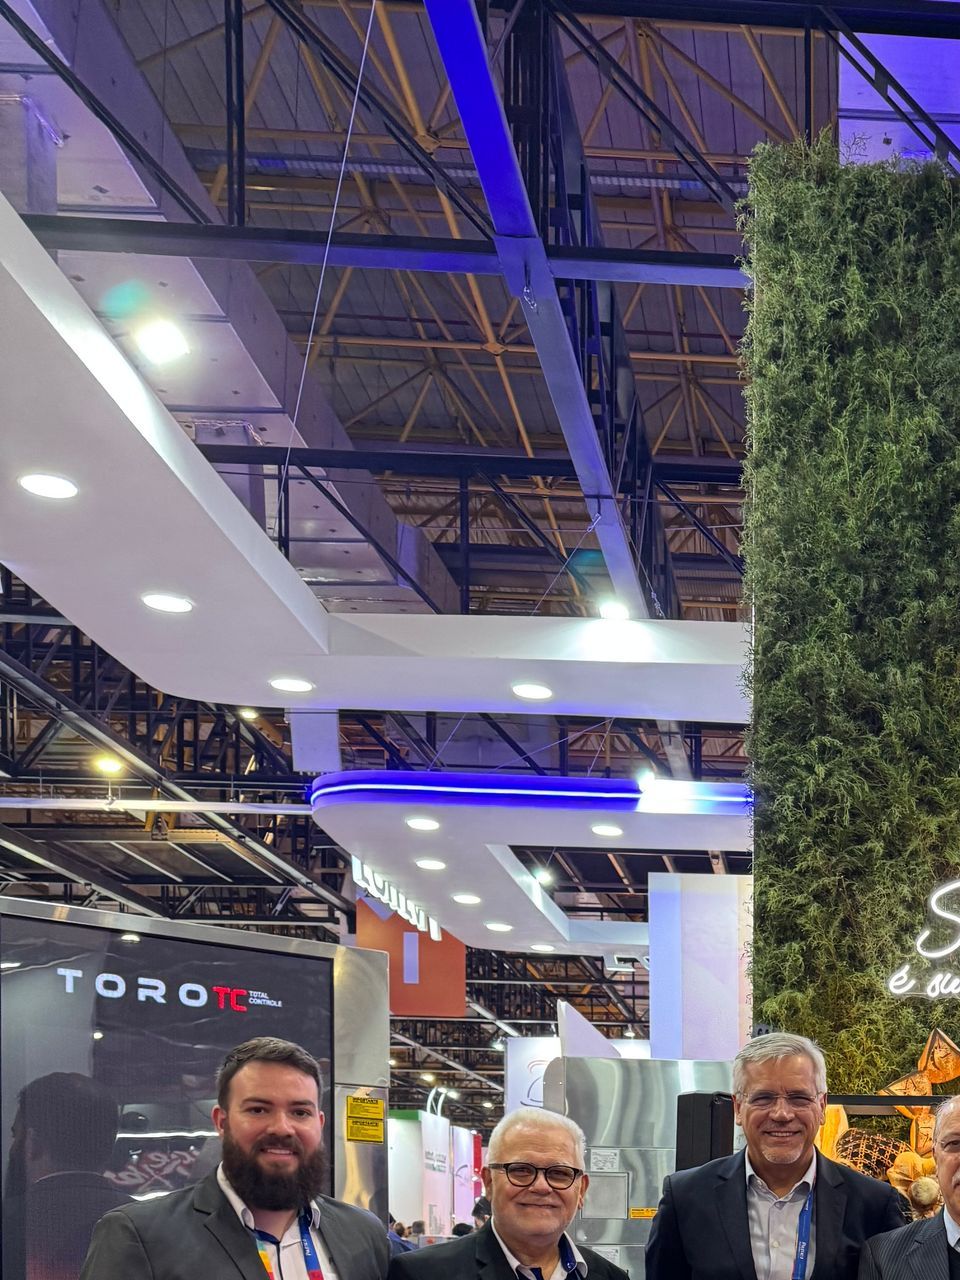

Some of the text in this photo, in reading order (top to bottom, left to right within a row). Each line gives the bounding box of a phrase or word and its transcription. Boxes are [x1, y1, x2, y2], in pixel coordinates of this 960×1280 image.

[57, 967, 248, 1012] TORO TC
[889, 964, 917, 994] é
[248, 990, 269, 999] TOTAL
